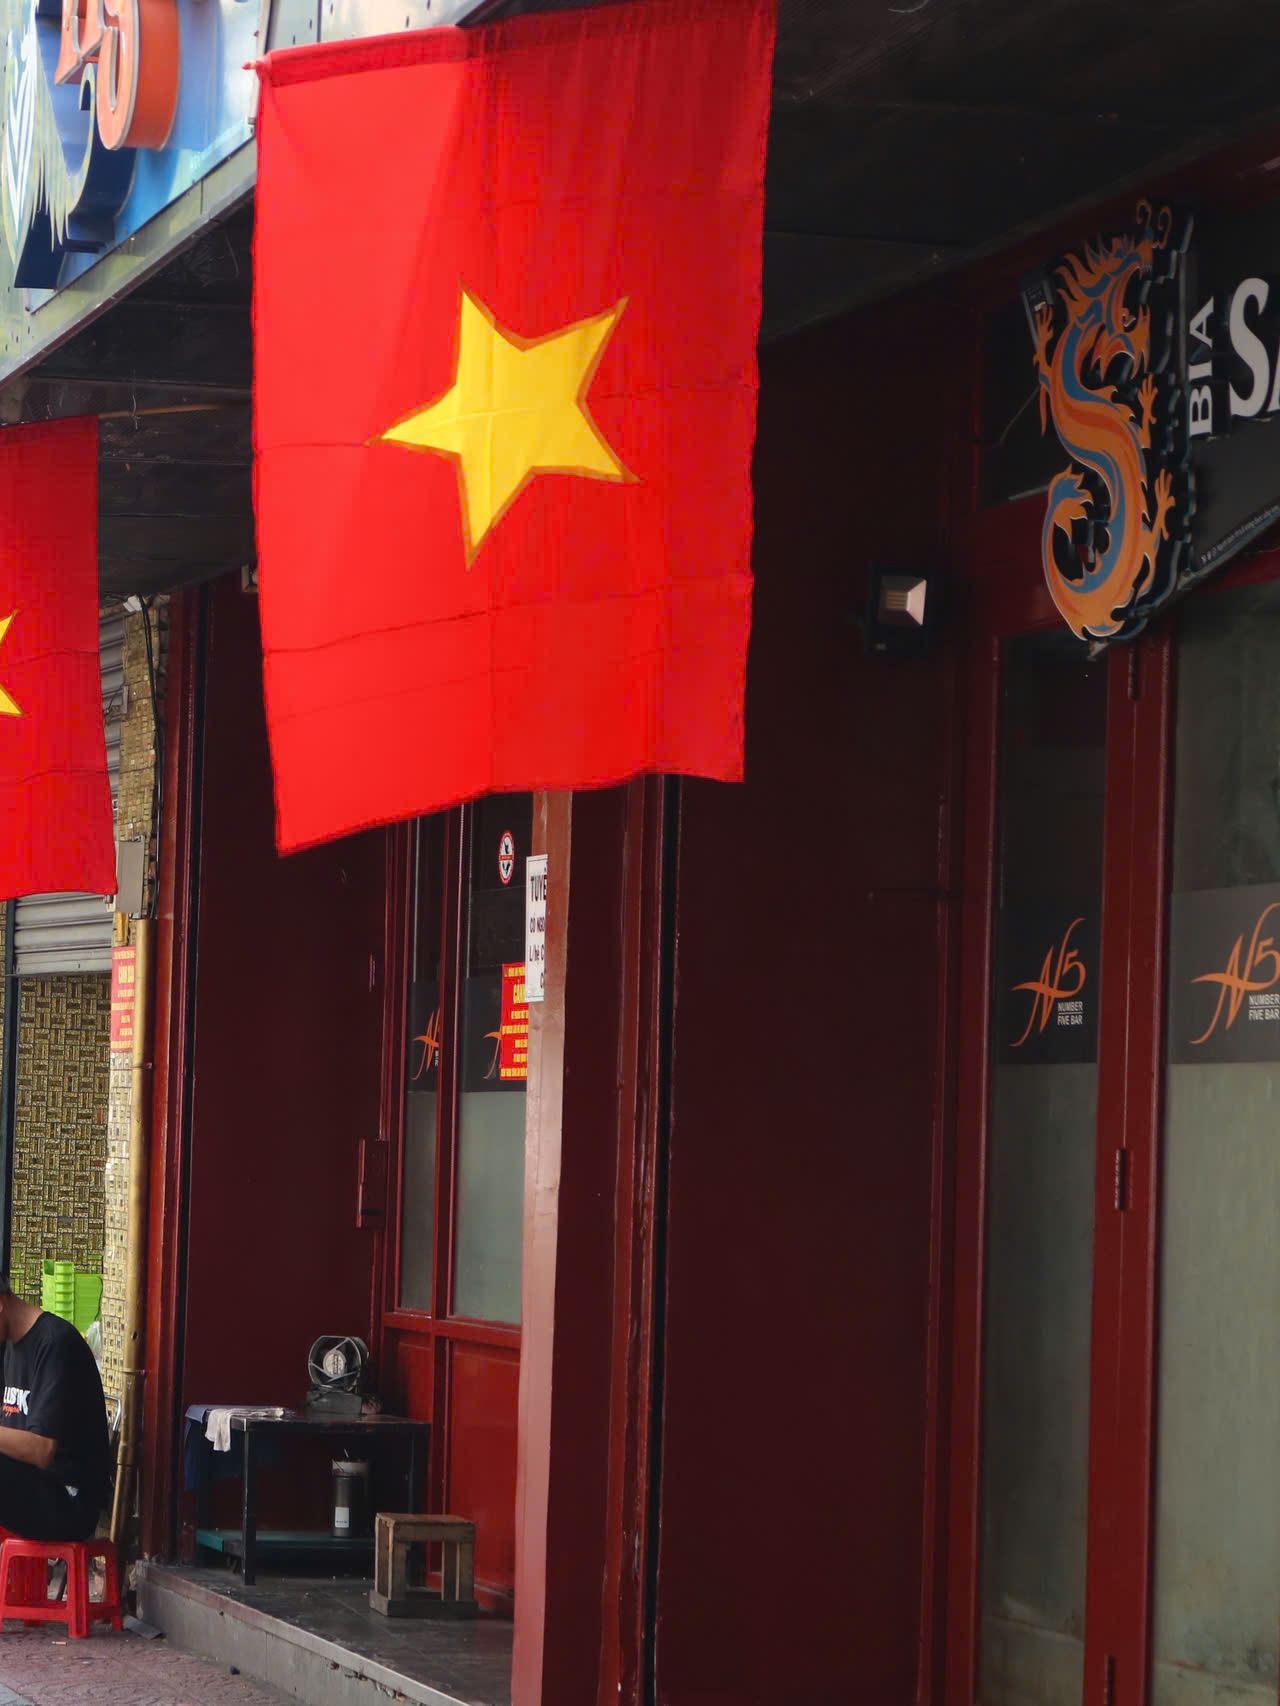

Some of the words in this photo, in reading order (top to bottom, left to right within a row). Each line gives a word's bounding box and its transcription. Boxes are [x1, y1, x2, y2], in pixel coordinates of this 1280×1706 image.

[1189, 296, 1214, 437] BIA
[1249, 994, 1280, 1006] NUMBER
[1058, 1001, 1083, 1012] NUMBER
[1057, 1015, 1070, 1025] FIVE
[1070, 1014, 1083, 1025] BAR
[1249, 1008, 1264, 1021] FIVE
[1265, 1007, 1280, 1020] BAR
